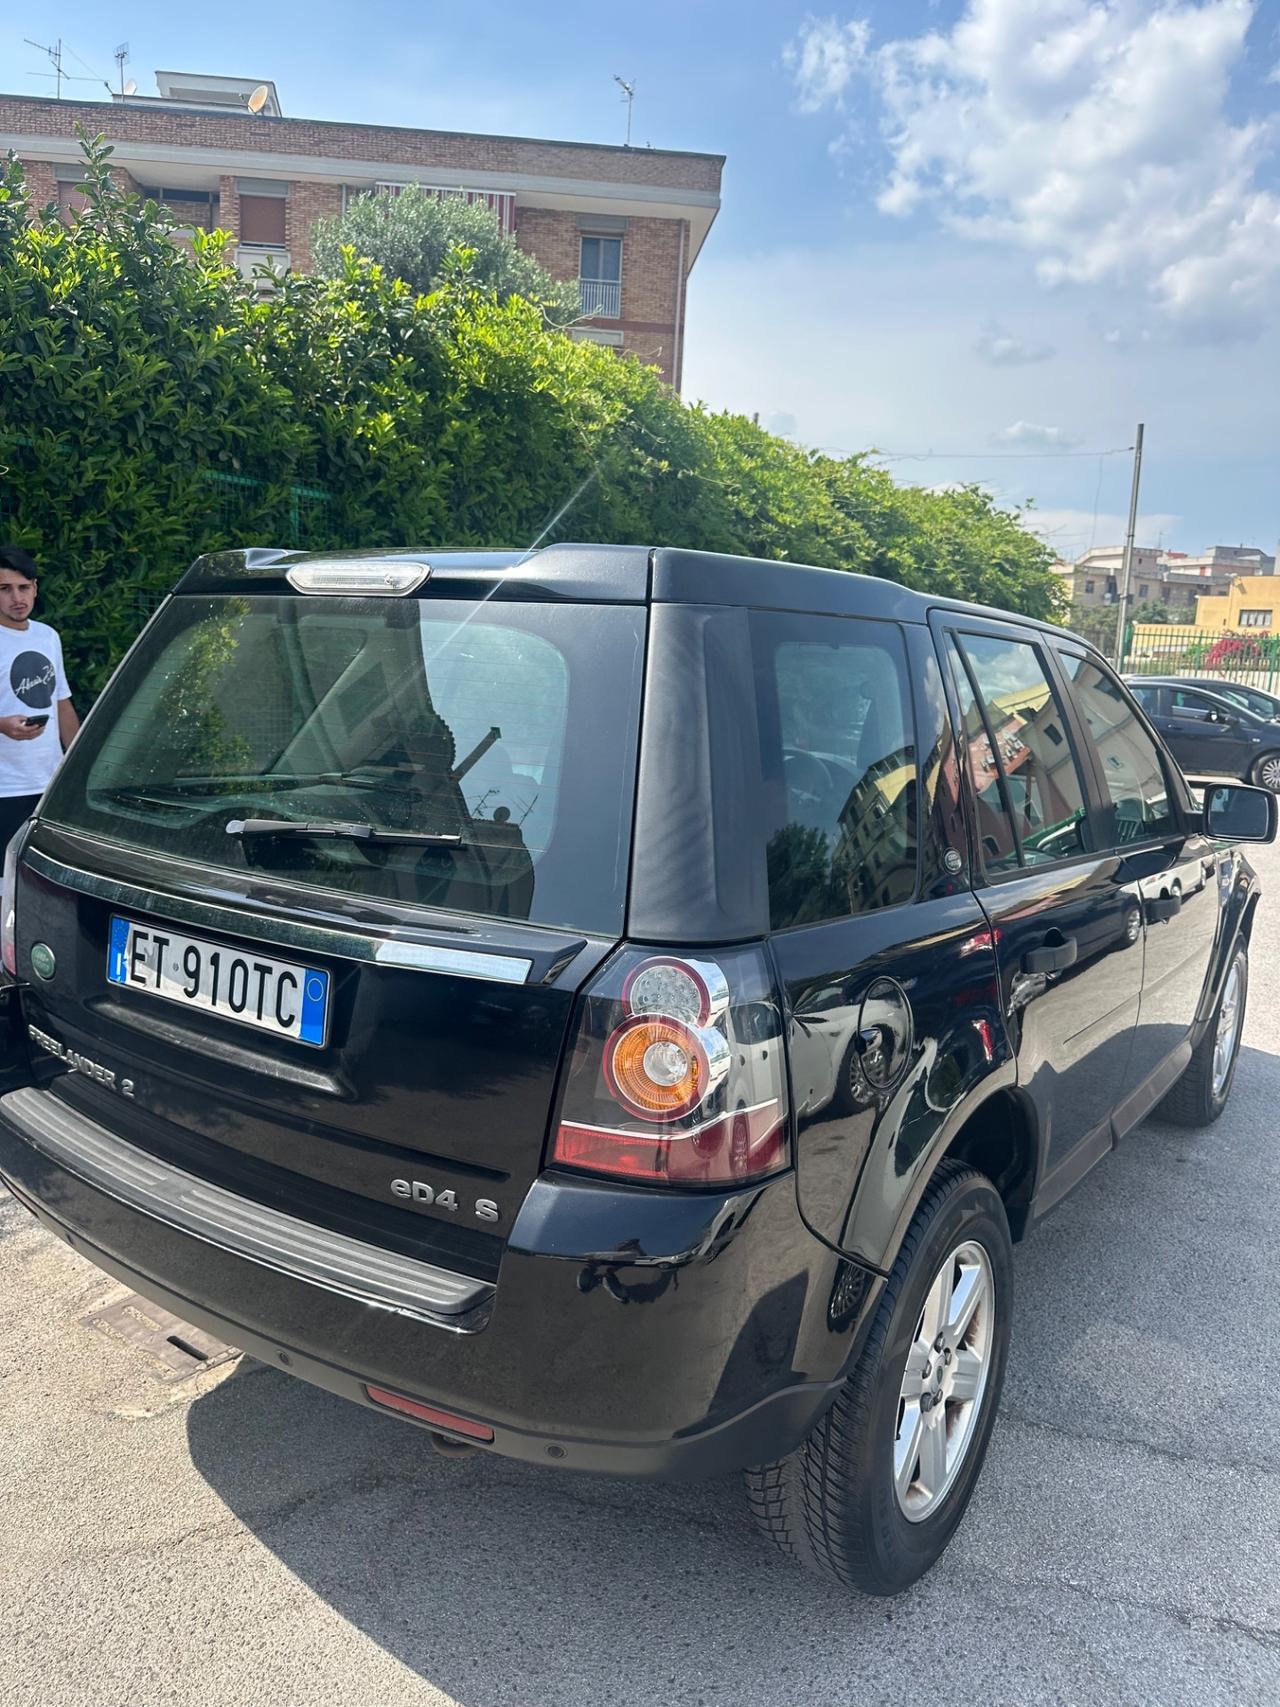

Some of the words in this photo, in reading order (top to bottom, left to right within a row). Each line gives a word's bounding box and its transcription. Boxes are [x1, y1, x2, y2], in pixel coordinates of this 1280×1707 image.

[131, 930, 170, 989] ET
[183, 945, 298, 1028] 910TC
[28, 1024, 117, 1090] FREELANDER
[122, 1079, 135, 1099] 2
[390, 1179, 459, 1212] eD4
[475, 1199, 499, 1222] S
